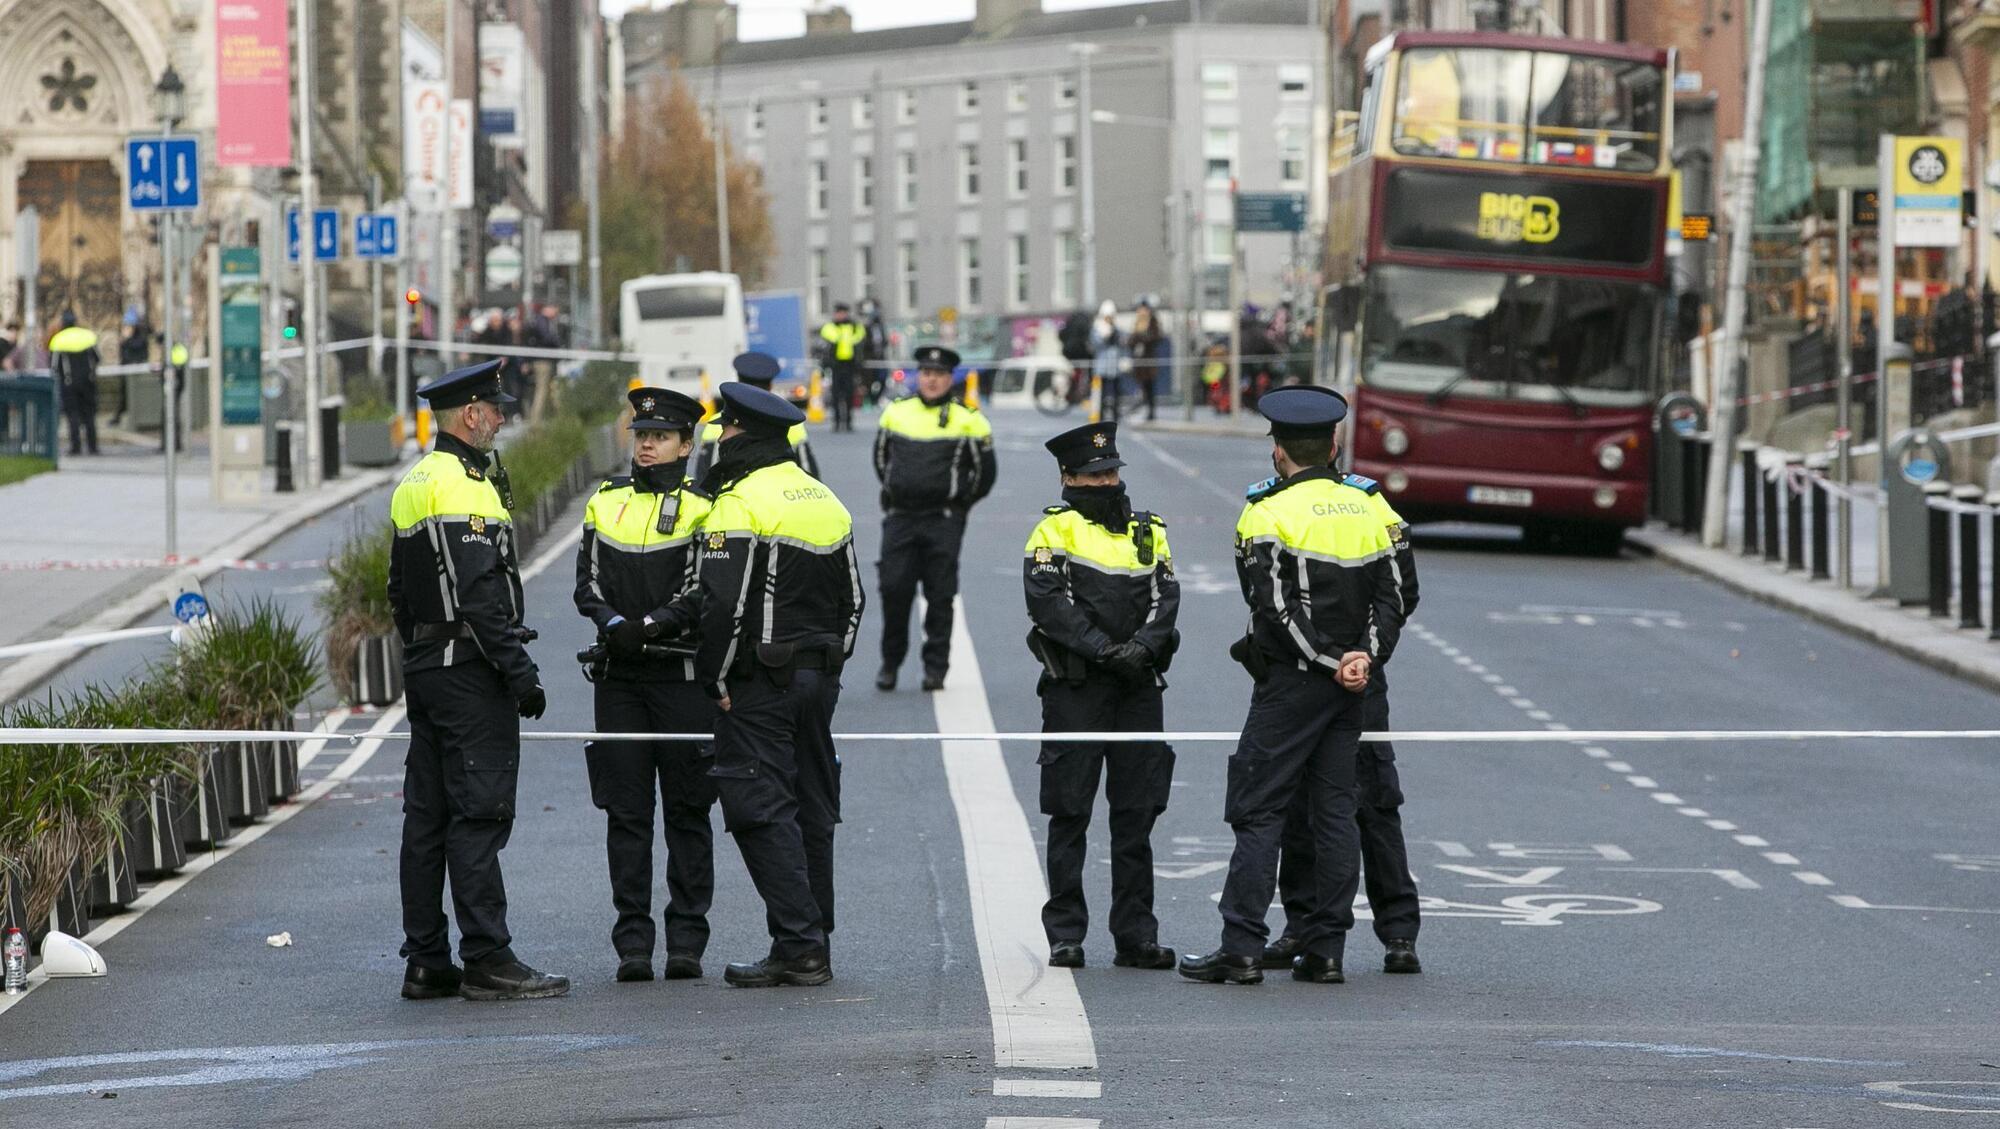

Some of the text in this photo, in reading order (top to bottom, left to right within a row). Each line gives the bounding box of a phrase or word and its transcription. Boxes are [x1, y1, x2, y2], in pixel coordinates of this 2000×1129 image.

[1480, 192, 1524, 219] BIG
[1479, 217, 1523, 243] BUS
[462, 533, 492, 546] GARDA
[702, 551, 730, 559] ARDA
